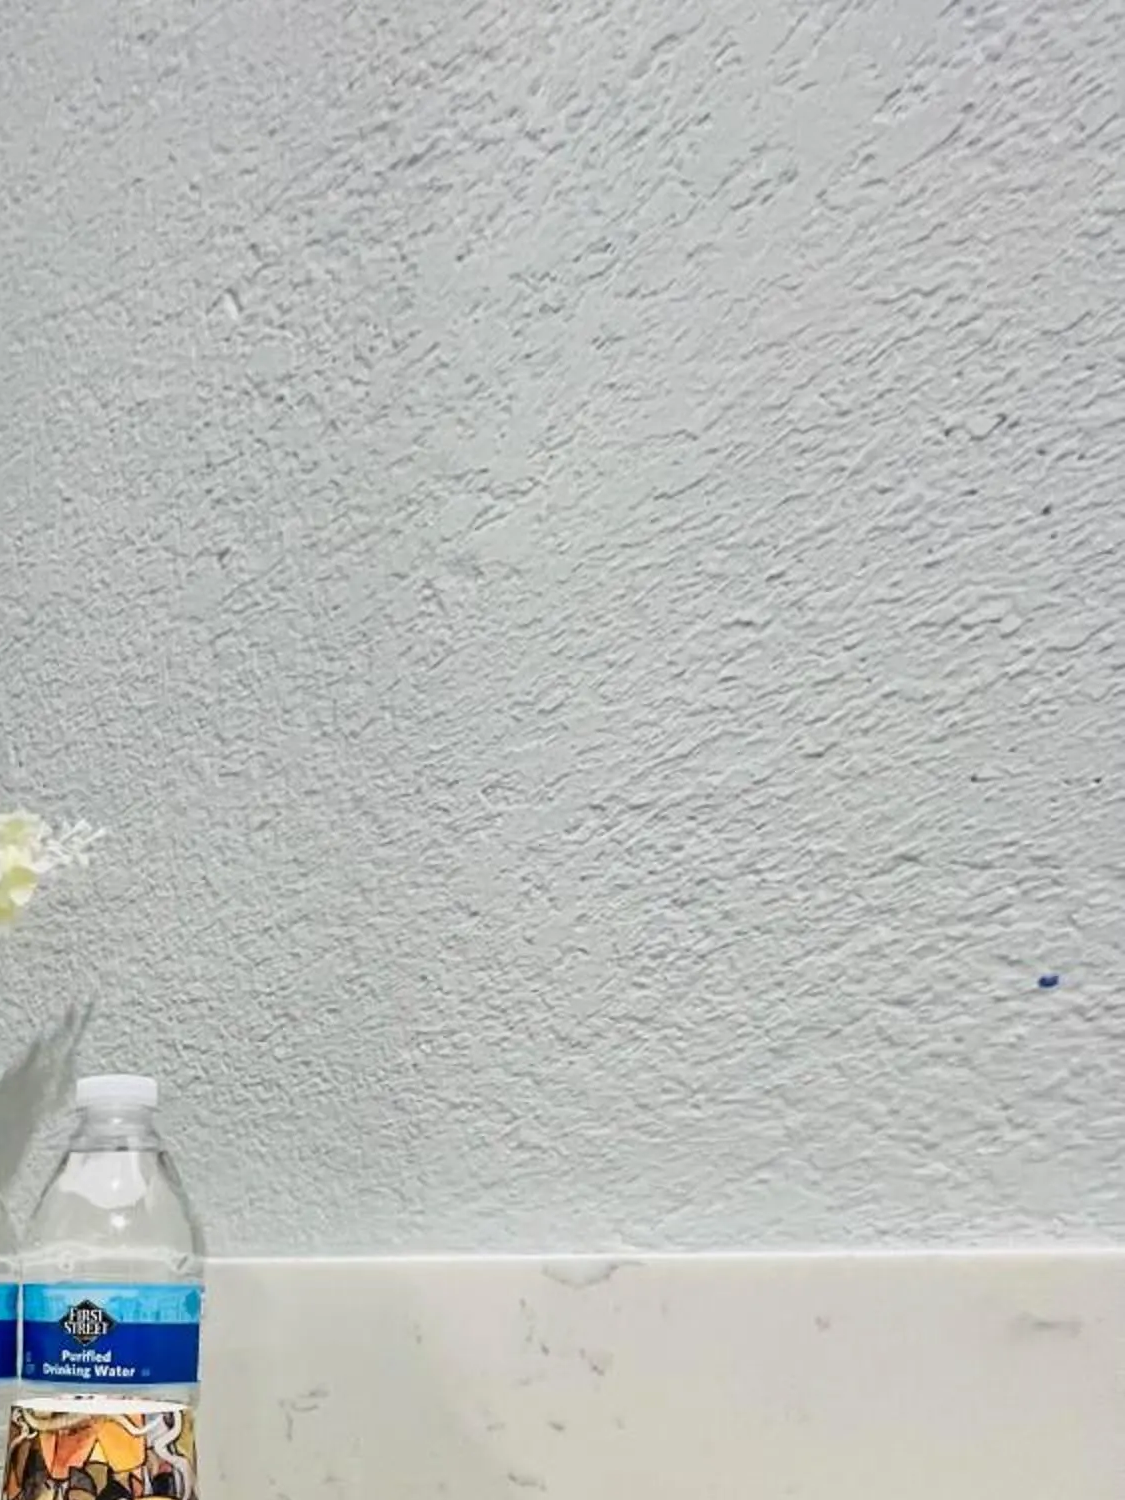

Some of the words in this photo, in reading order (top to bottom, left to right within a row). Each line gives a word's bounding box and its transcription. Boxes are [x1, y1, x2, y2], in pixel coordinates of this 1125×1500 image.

[69, 1308, 103, 1322] FIRST
[63, 1321, 108, 1335] STREET
[62, 1350, 112, 1363] Purified
[42, 1363, 91, 1378] Drinking
[93, 1365, 135, 1377] Water
